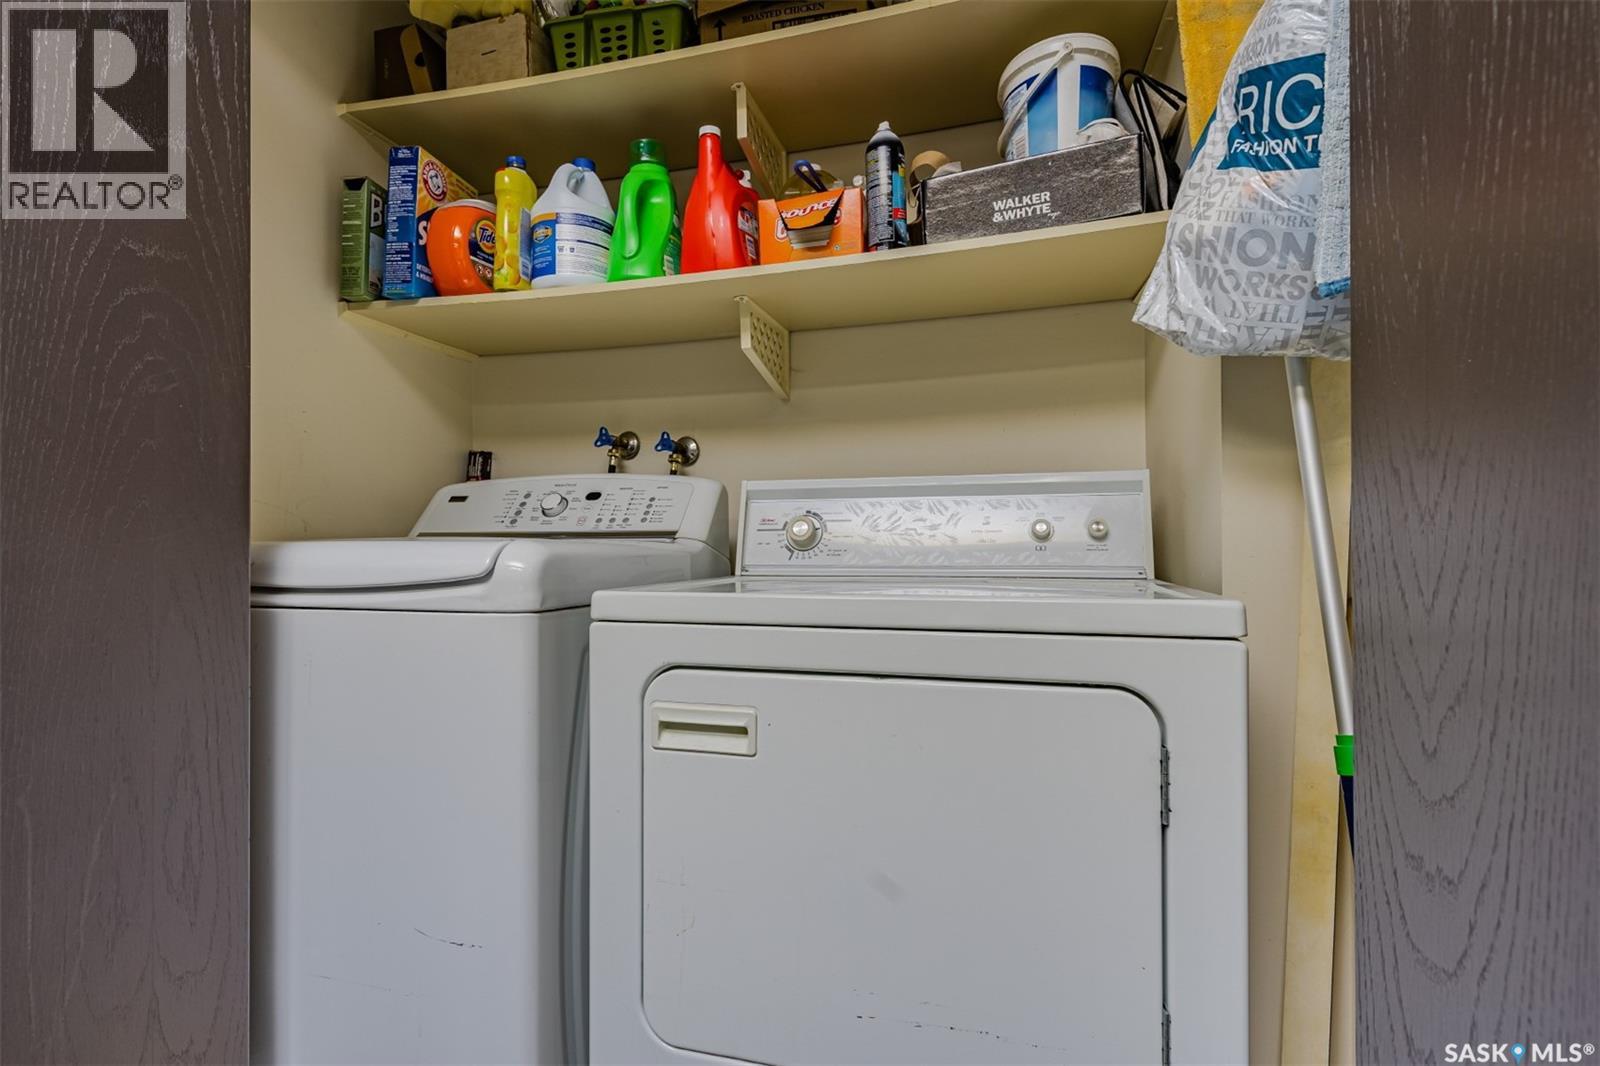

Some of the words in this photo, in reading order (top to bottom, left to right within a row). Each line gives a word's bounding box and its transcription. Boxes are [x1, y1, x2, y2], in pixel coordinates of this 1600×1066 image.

[742, 10, 782, 24] ROASTED
[783, 2, 826, 16] CHICKEN
[1230, 139, 1297, 156] FASHION
[993, 191, 1051, 211] WALKER
[992, 202, 1052, 222] &WHYTE
[1215, 209, 1257, 224] THAT
[1194, 263, 1308, 300] WORKS
